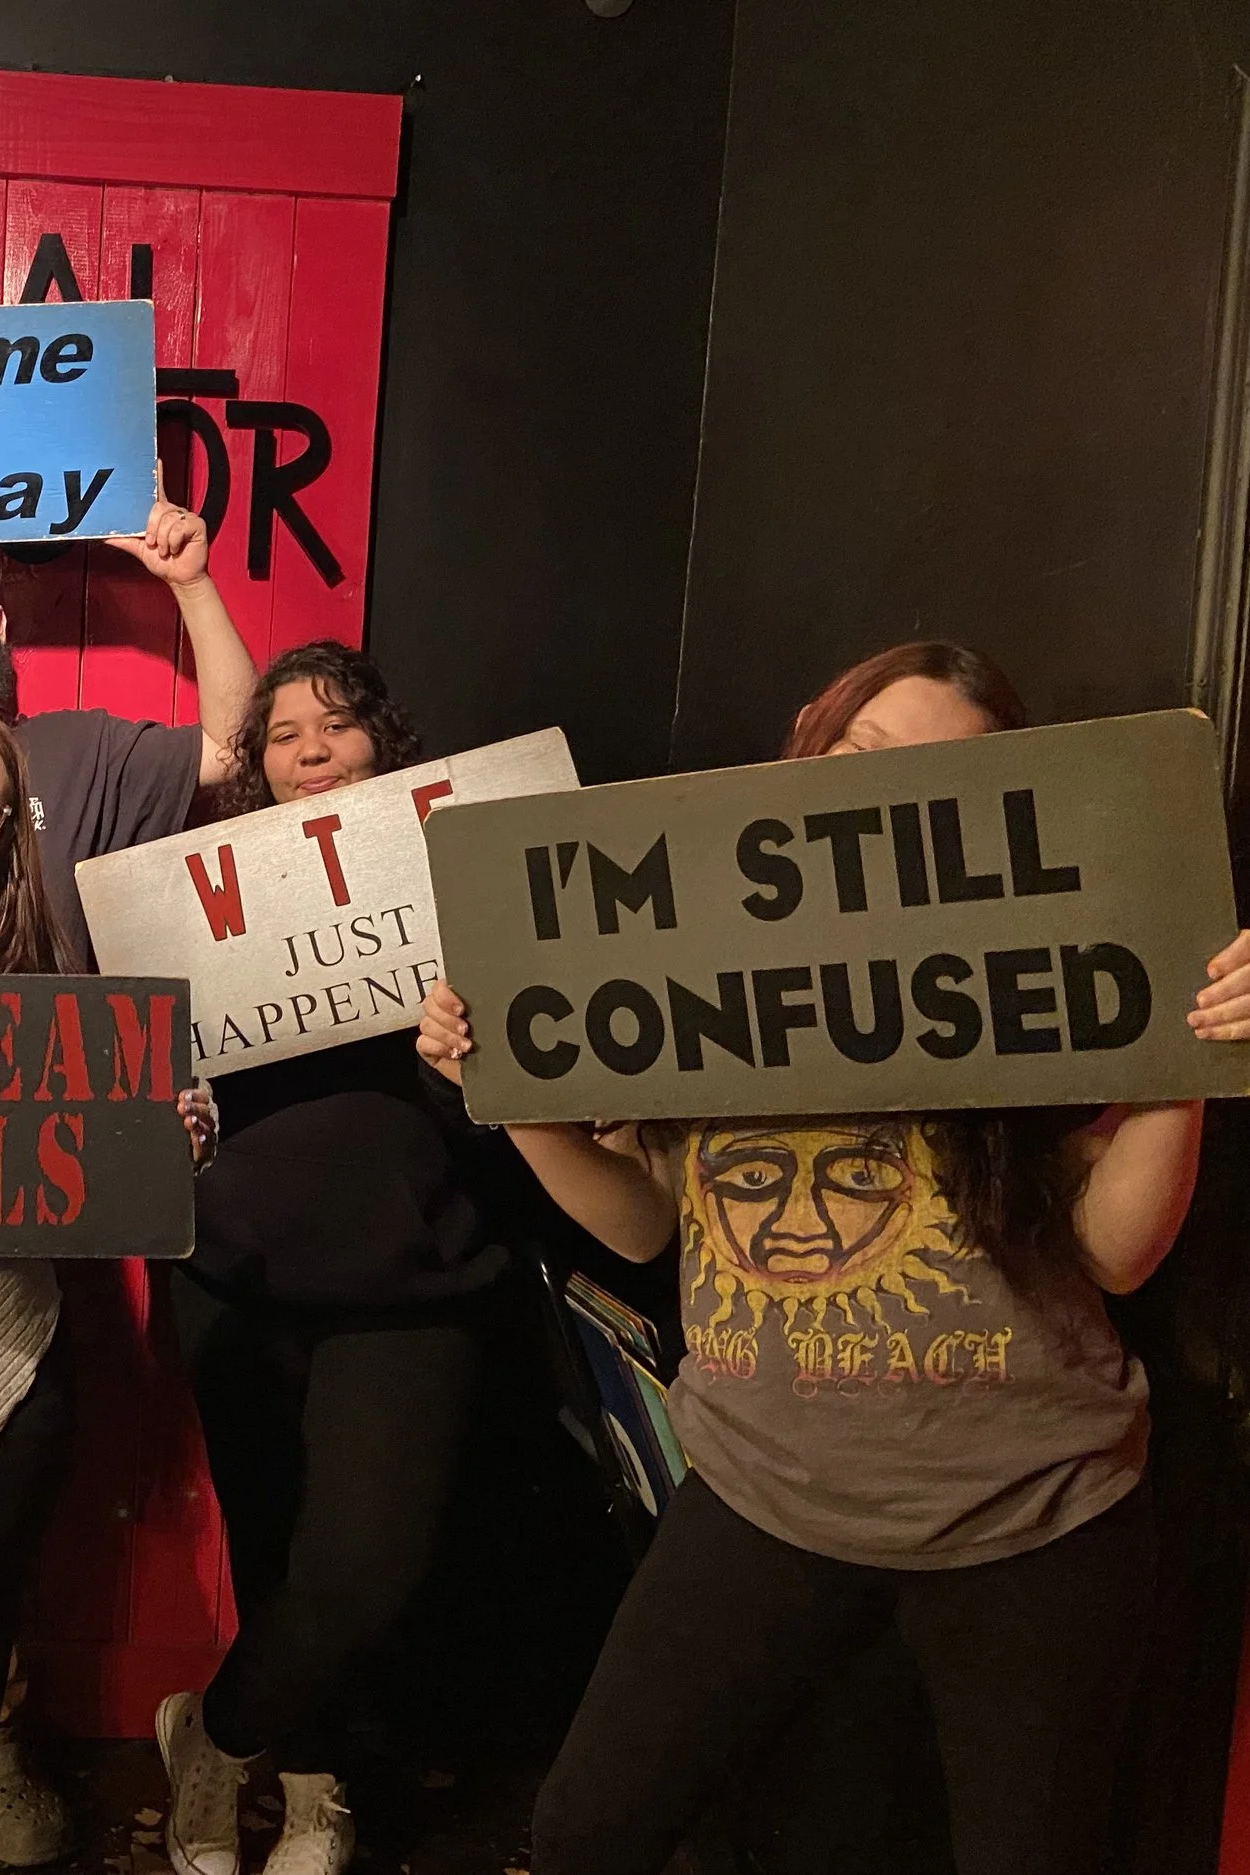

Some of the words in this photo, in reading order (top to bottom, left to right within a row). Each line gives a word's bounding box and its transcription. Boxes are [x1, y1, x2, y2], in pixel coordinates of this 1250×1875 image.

[524, 831, 679, 940] I'M
[735, 788, 1082, 922] STILL
[281, 904, 416, 978] JUST
[191, 958, 440, 1061] HAPPENE
[506, 941, 1152, 1080] CONFUSED
